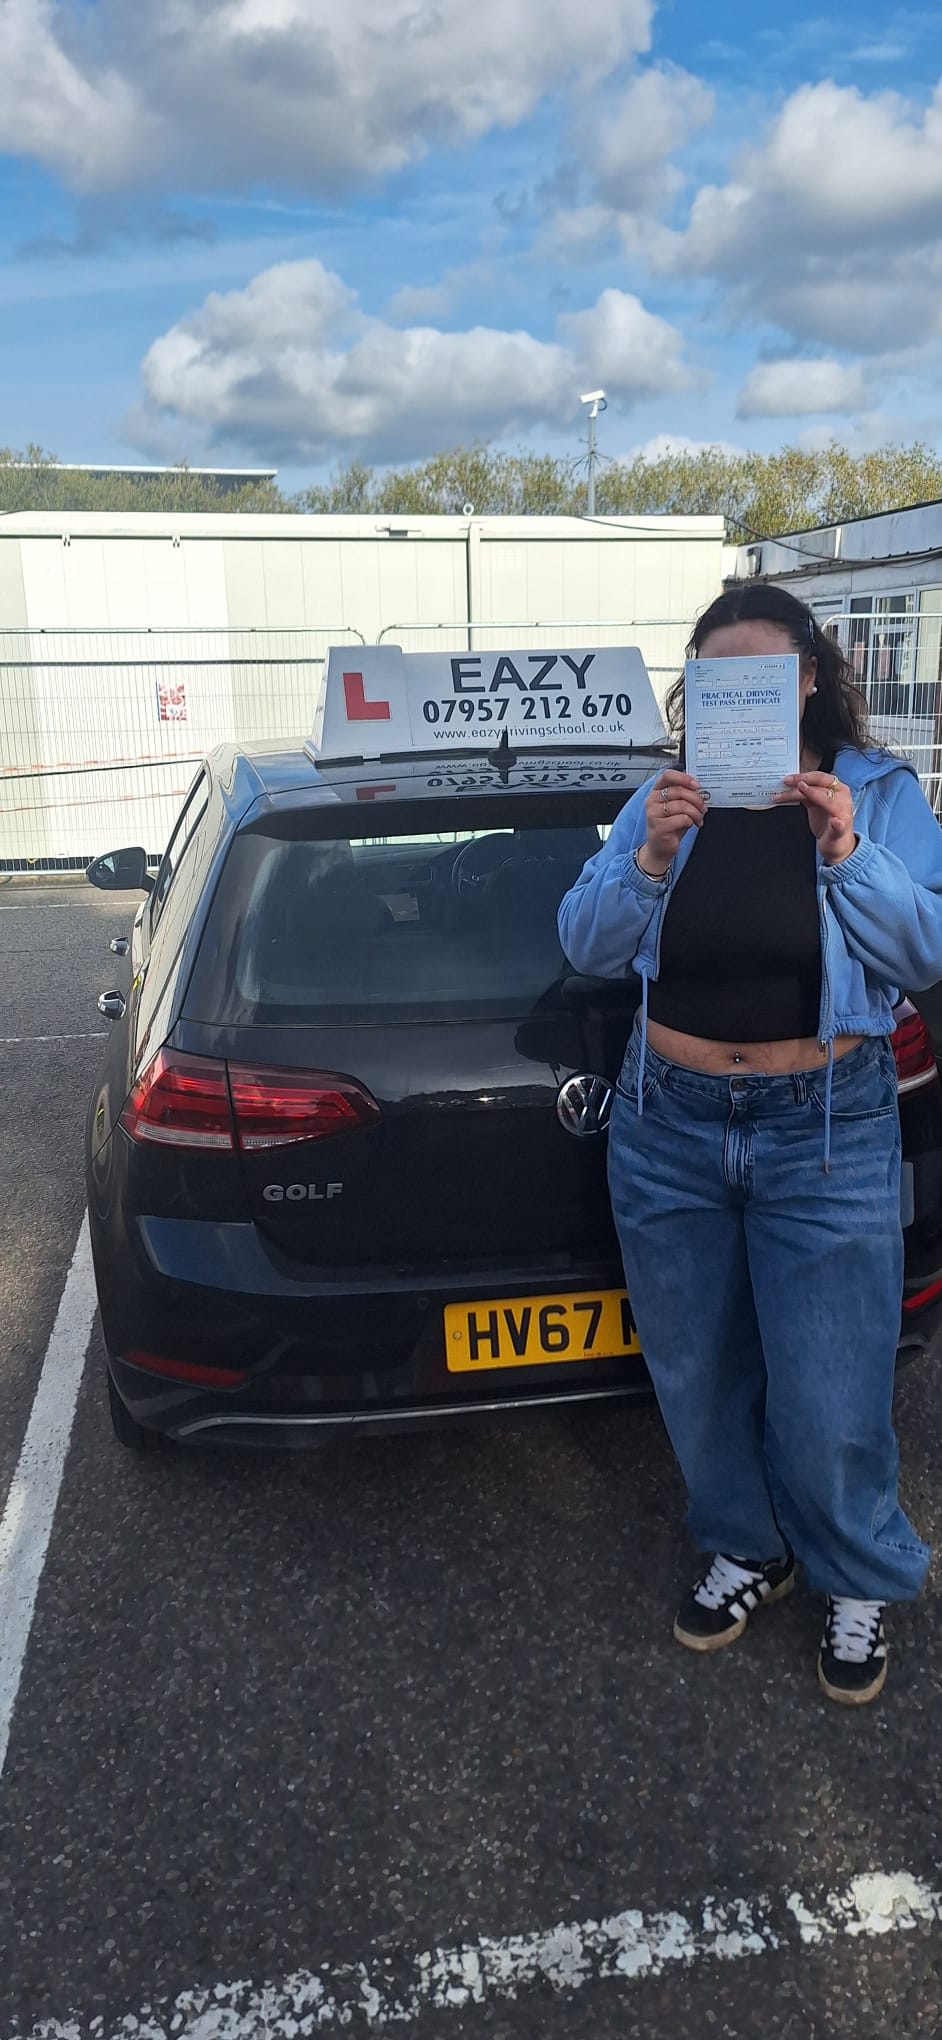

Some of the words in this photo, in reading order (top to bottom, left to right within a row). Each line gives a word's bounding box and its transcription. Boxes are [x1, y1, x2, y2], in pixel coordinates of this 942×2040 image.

[450, 654, 596, 694] EAZY
[342, 671, 391, 721] L
[422, 697, 510, 724] 07957
[520, 695, 571, 721] 212
[582, 693, 632, 719] 670
[701, 690, 744, 700] PRACTICAL
[746, 689, 782, 698] DRIVING
[737, 697, 781, 706] CERTIFICATE
[262, 1181, 344, 1202] GOLF
[467, 1300, 603, 1362] HV67
